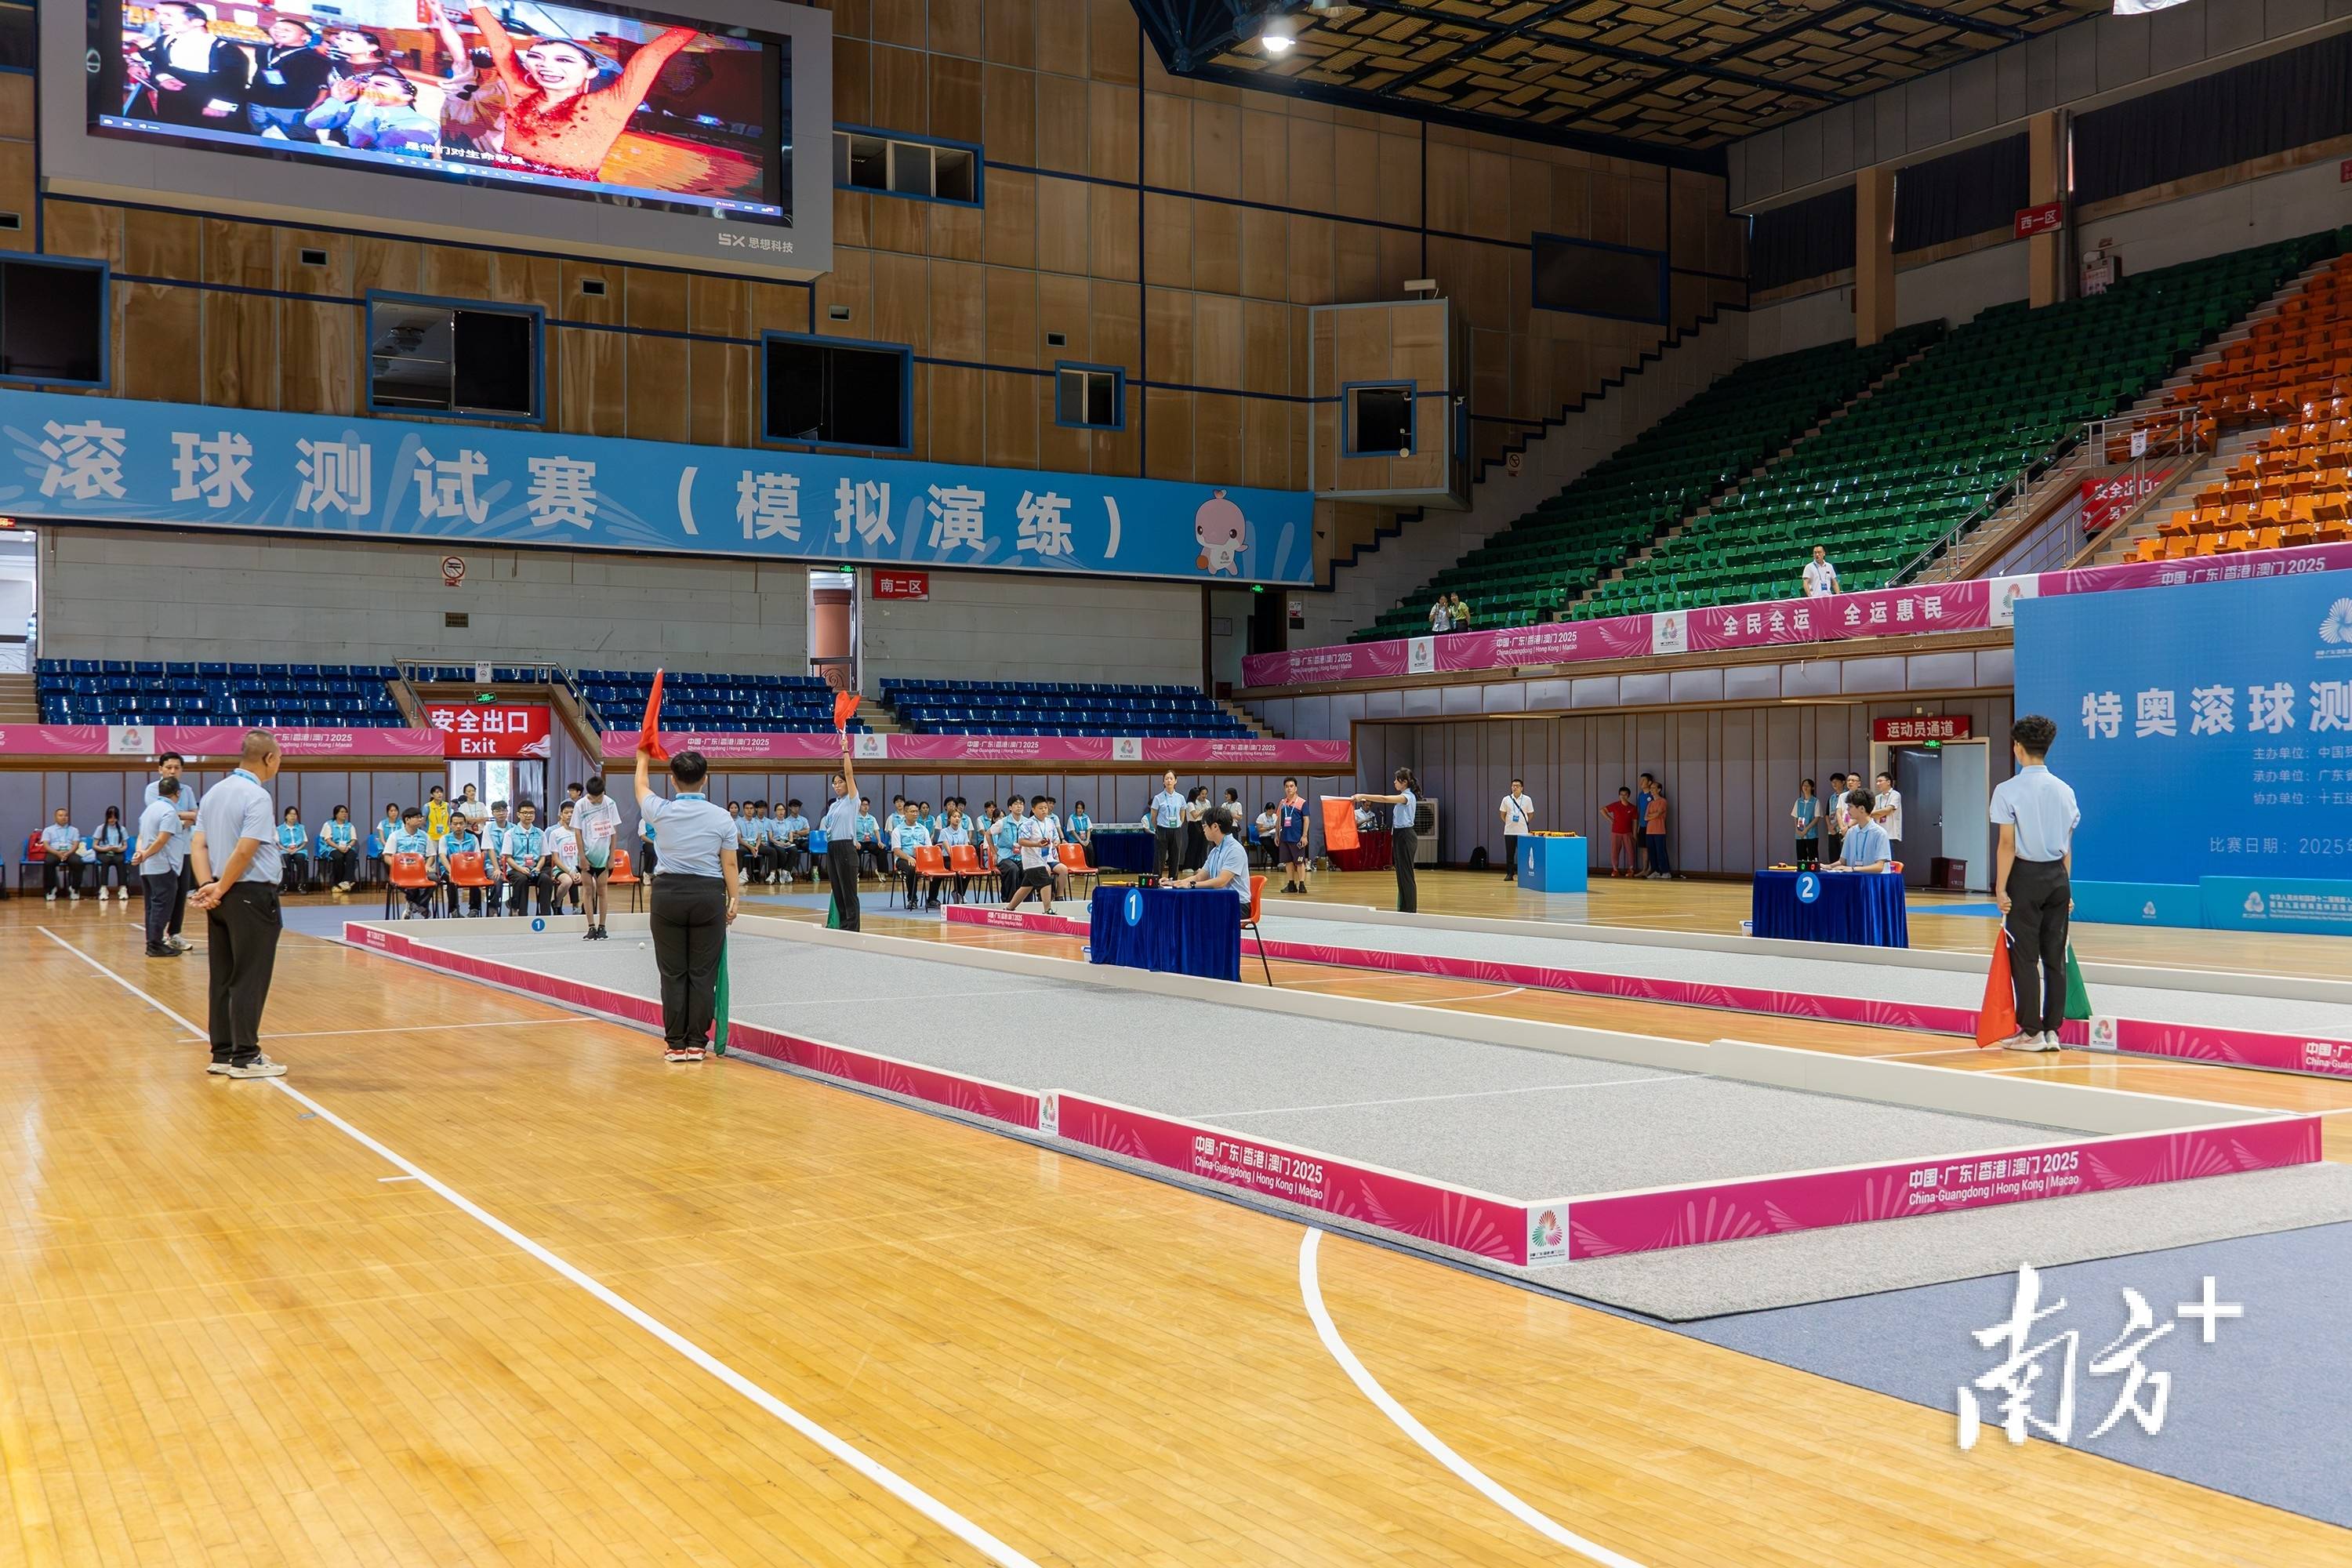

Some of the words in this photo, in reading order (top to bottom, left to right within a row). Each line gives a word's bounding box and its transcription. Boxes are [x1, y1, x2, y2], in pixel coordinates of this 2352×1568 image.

[2020, 209, 2056, 230] 西一区
[749, 237, 794, 253] 思想科技
[2288, 557, 2326, 574] 2025
[880, 579, 922, 593] 南二区
[1723, 608, 1809, 636] 全民全运
[1844, 596, 1942, 626] 全运惠民
[1559, 631, 1577, 642] 2025
[1338, 652, 1352, 662] 2025
[2082, 680, 2352, 739] 特奥滚球测
[432, 709, 528, 734] 安全出口
[1887, 720, 1954, 738] 运动员通道
[461, 737, 496, 753] Exit
[1802, 876, 1813, 898] 2
[1129, 894, 1136, 920] 1
[2306, 1042, 2352, 1058] 中国·广
[1292, 1159, 1323, 1184] 2025
[2043, 1151, 2079, 1174] 2025
[1256, 1170, 1275, 1189] Hong
[1275, 1178, 1294, 1195] Kong
[1298, 1182, 1323, 1200] Macao
[1996, 1180, 2020, 1196] Hong
[2021, 1176, 2045, 1192] Kong
[2050, 1173, 2079, 1188] Macao
